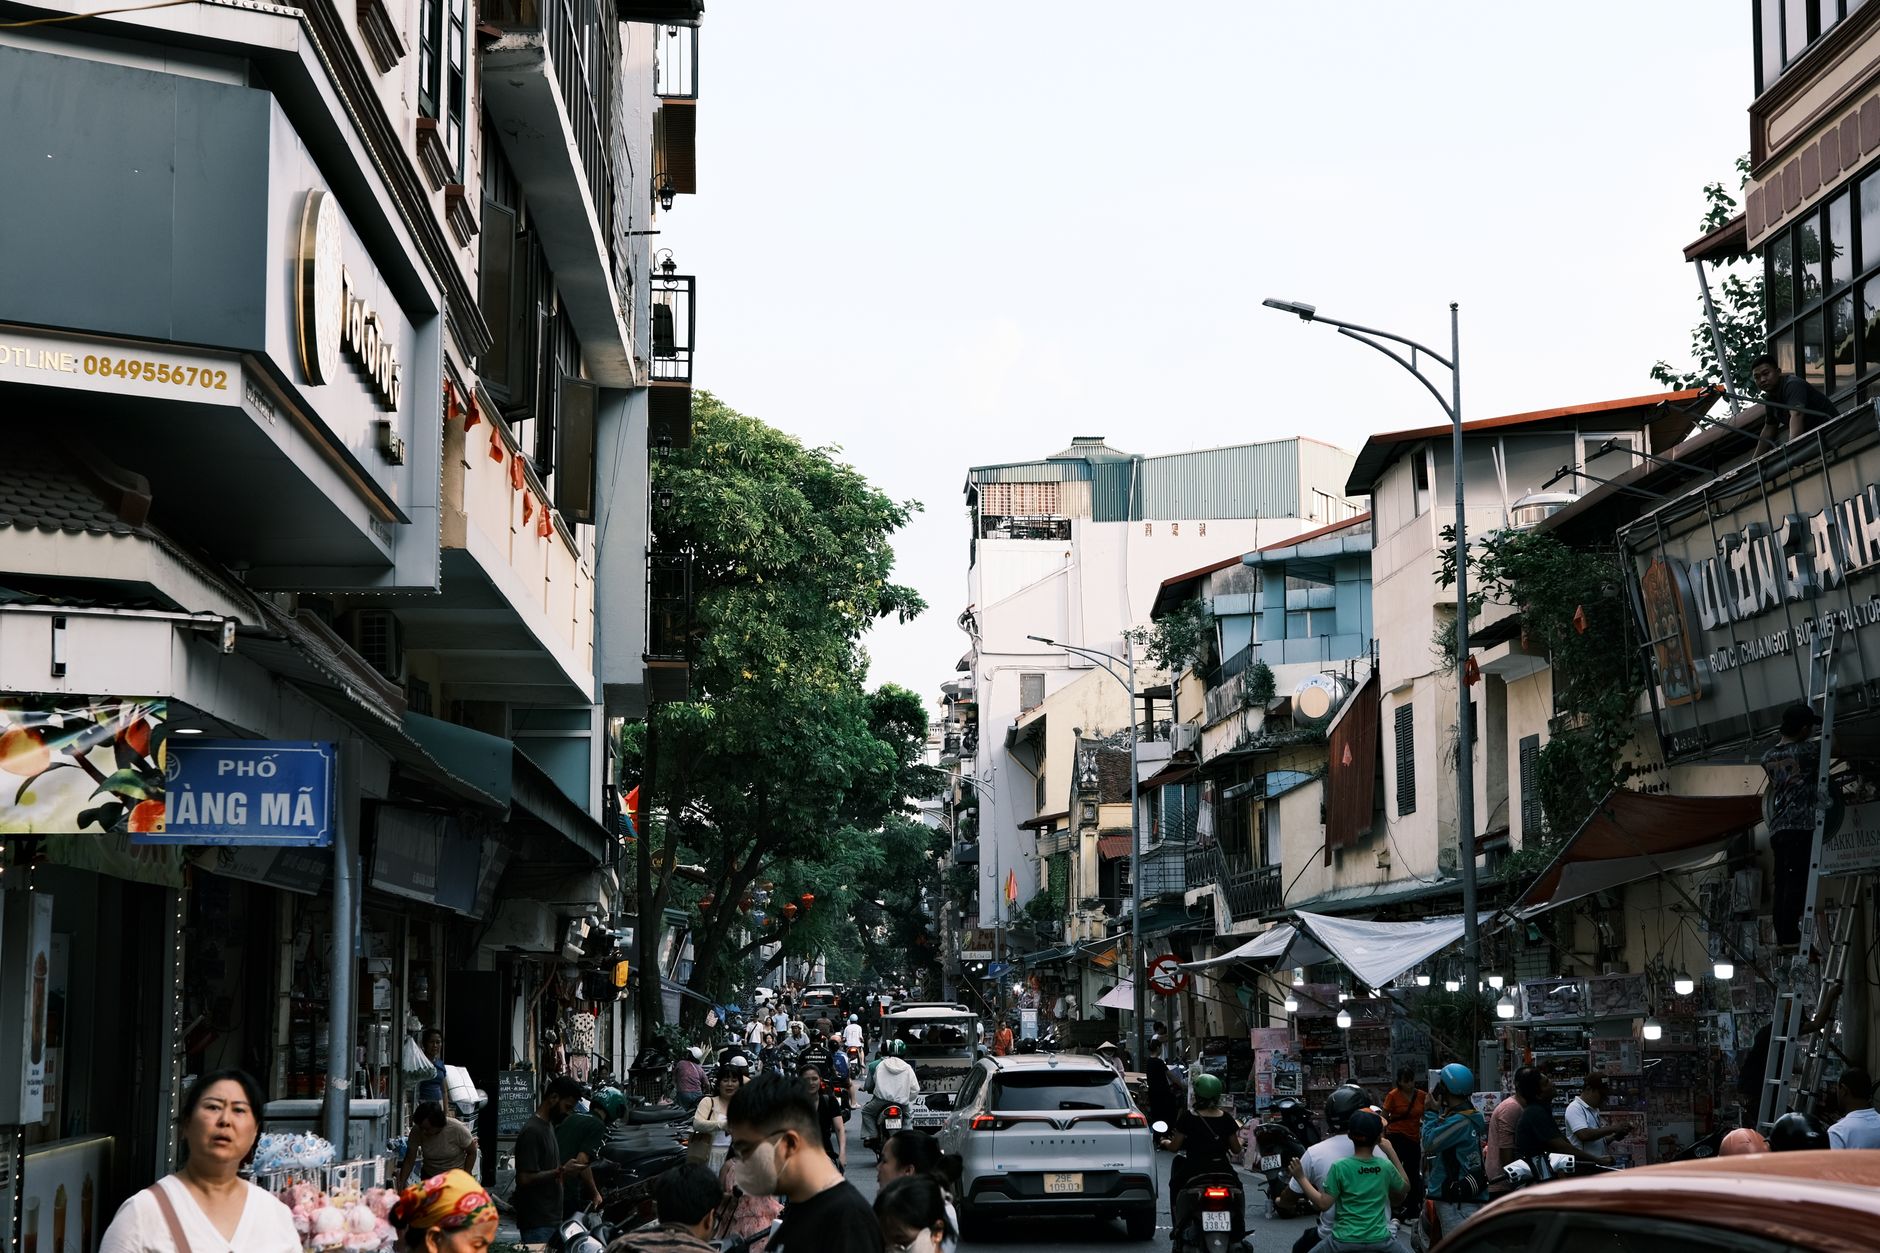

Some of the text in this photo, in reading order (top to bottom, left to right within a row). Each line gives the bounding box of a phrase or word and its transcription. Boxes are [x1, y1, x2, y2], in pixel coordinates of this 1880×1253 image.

[83, 354, 228, 390] 0849556702
[217, 754, 279, 778] PHỐ
[260, 786, 315, 826] MÃ
[1358, 1166, 1381, 1175] Jeep
[1055, 1173, 1072, 1183] 29E
[1050, 1182, 1080, 1192] 109.03
[1206, 1212, 1227, 1221] 34-E1
